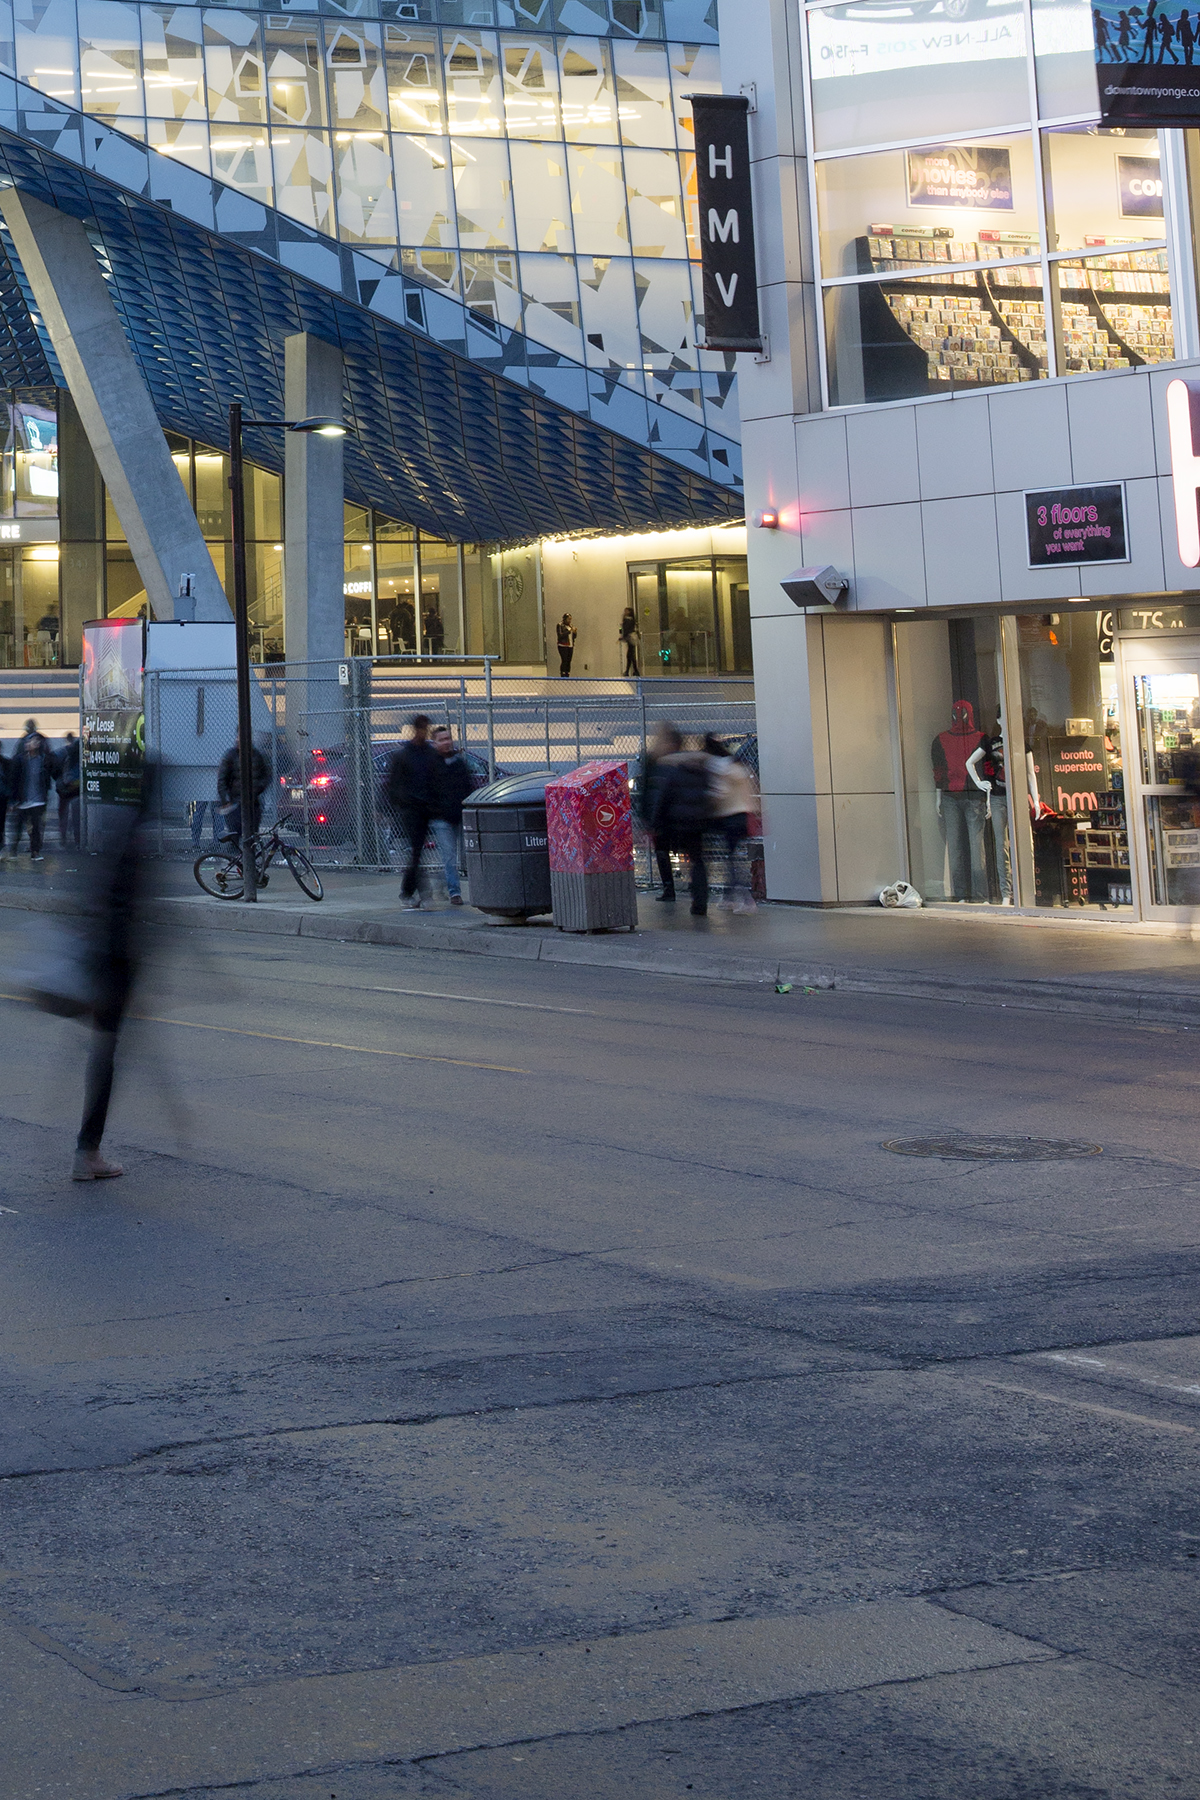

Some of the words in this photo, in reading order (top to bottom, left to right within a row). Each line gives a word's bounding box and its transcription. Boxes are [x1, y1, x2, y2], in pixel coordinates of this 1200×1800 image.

[925, 156, 949, 167] more
[912, 166, 977, 185] movies
[927, 185, 948, 196] than
[950, 187, 989, 199] anybody
[990, 189, 1010, 200] else
[708, 144, 740, 307] HMV
[901, 227, 926, 235] comedy
[1037, 506, 1047, 526] 3
[1051, 503, 1098, 525] floors
[1053, 527, 1062, 539] of
[1064, 525, 1111, 540] everything
[1046, 543, 1061, 555] you
[1062, 540, 1085, 552] want
[96, 718, 114, 732] Lease
[1061, 750, 1094, 760] toronto
[1054, 762, 1103, 774] superstore
[87, 780, 100, 792] CBRE
[525, 836, 547, 847] Litter
